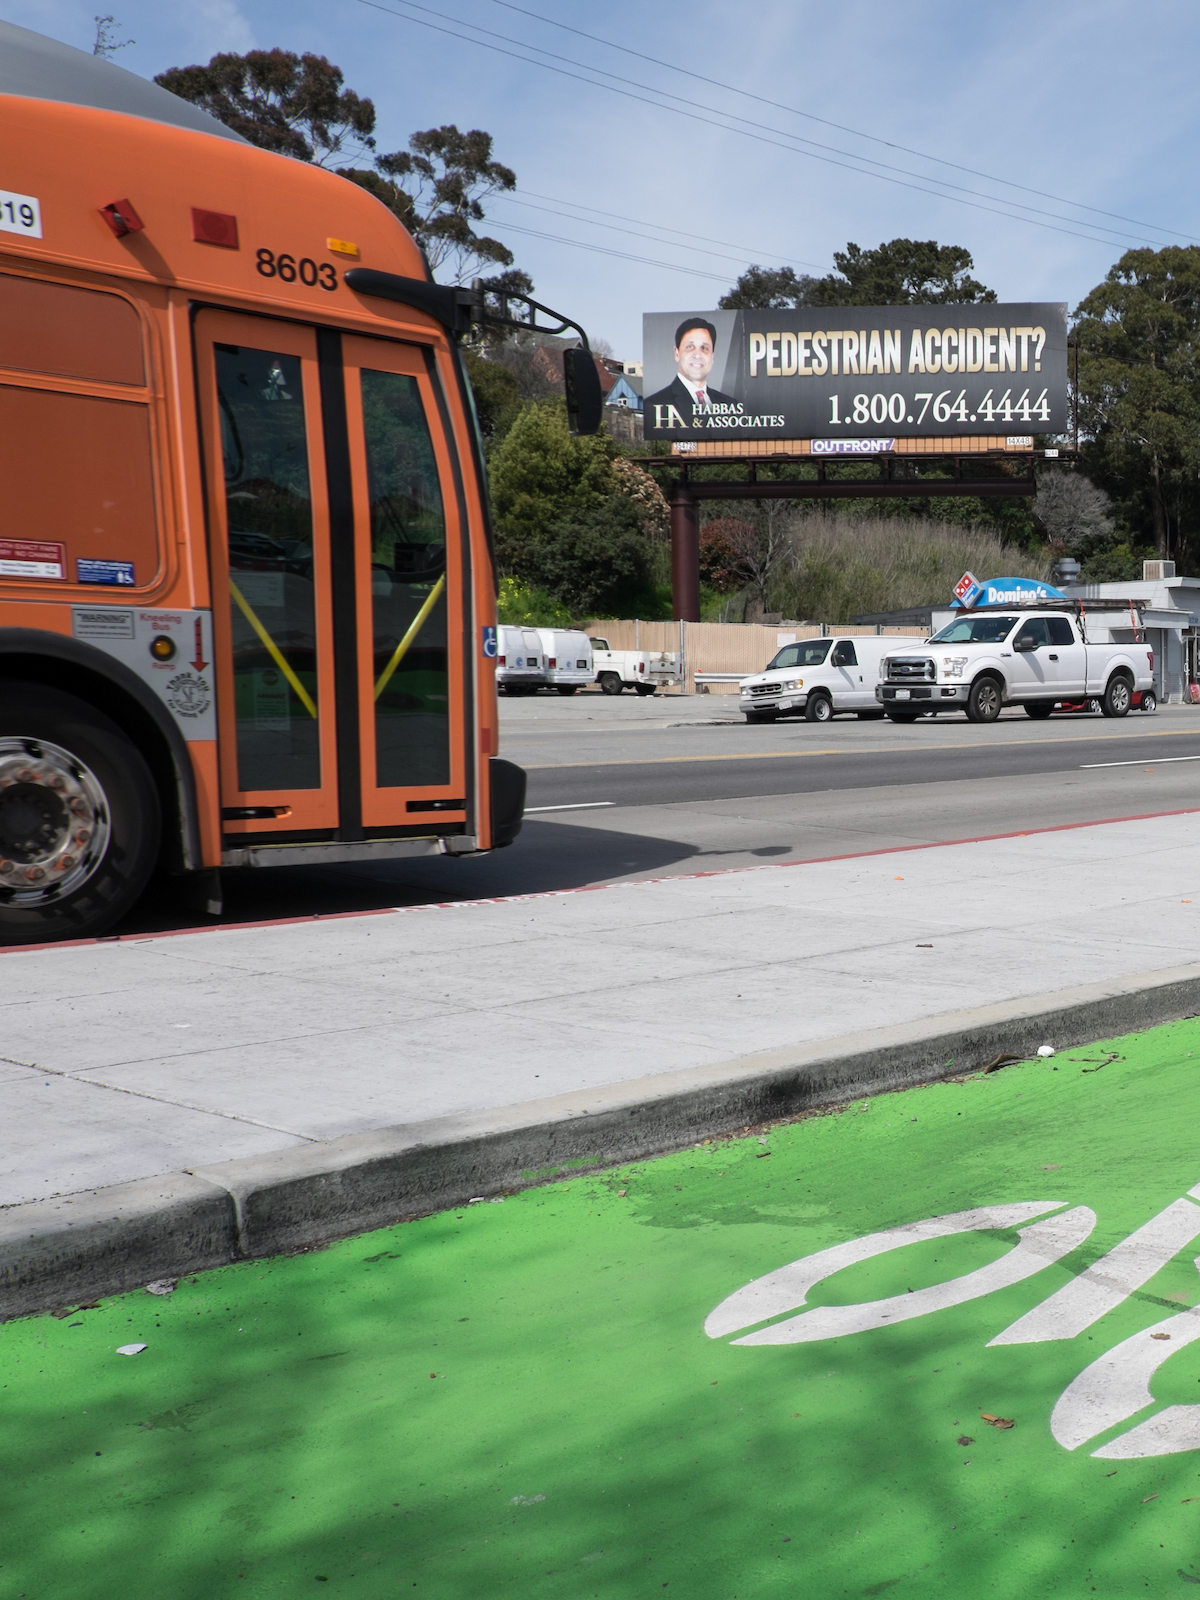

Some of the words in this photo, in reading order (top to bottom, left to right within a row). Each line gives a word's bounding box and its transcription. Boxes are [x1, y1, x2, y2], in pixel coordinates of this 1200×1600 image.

[0, 200, 35, 228] 19
[256, 247, 338, 291] 8603
[749, 329, 902, 377] PEDESTRIAN
[907, 325, 1047, 374] ACCIDENT?
[691, 402, 744, 416] HABBAS
[828, 387, 1052, 425] 1.800.764.4444
[653, 404, 690, 429] HA
[692, 417, 703, 428] &
[705, 415, 785, 428] ASSOCIATES
[813, 439, 891, 452] OUTFRONT
[1007, 436, 1031, 446] 14X48
[988, 585, 1047, 603] Domino's
[139, 612, 182, 625] Kneeling
[151, 621, 171, 631] Bus
[151, 662, 177, 671] Ramp
